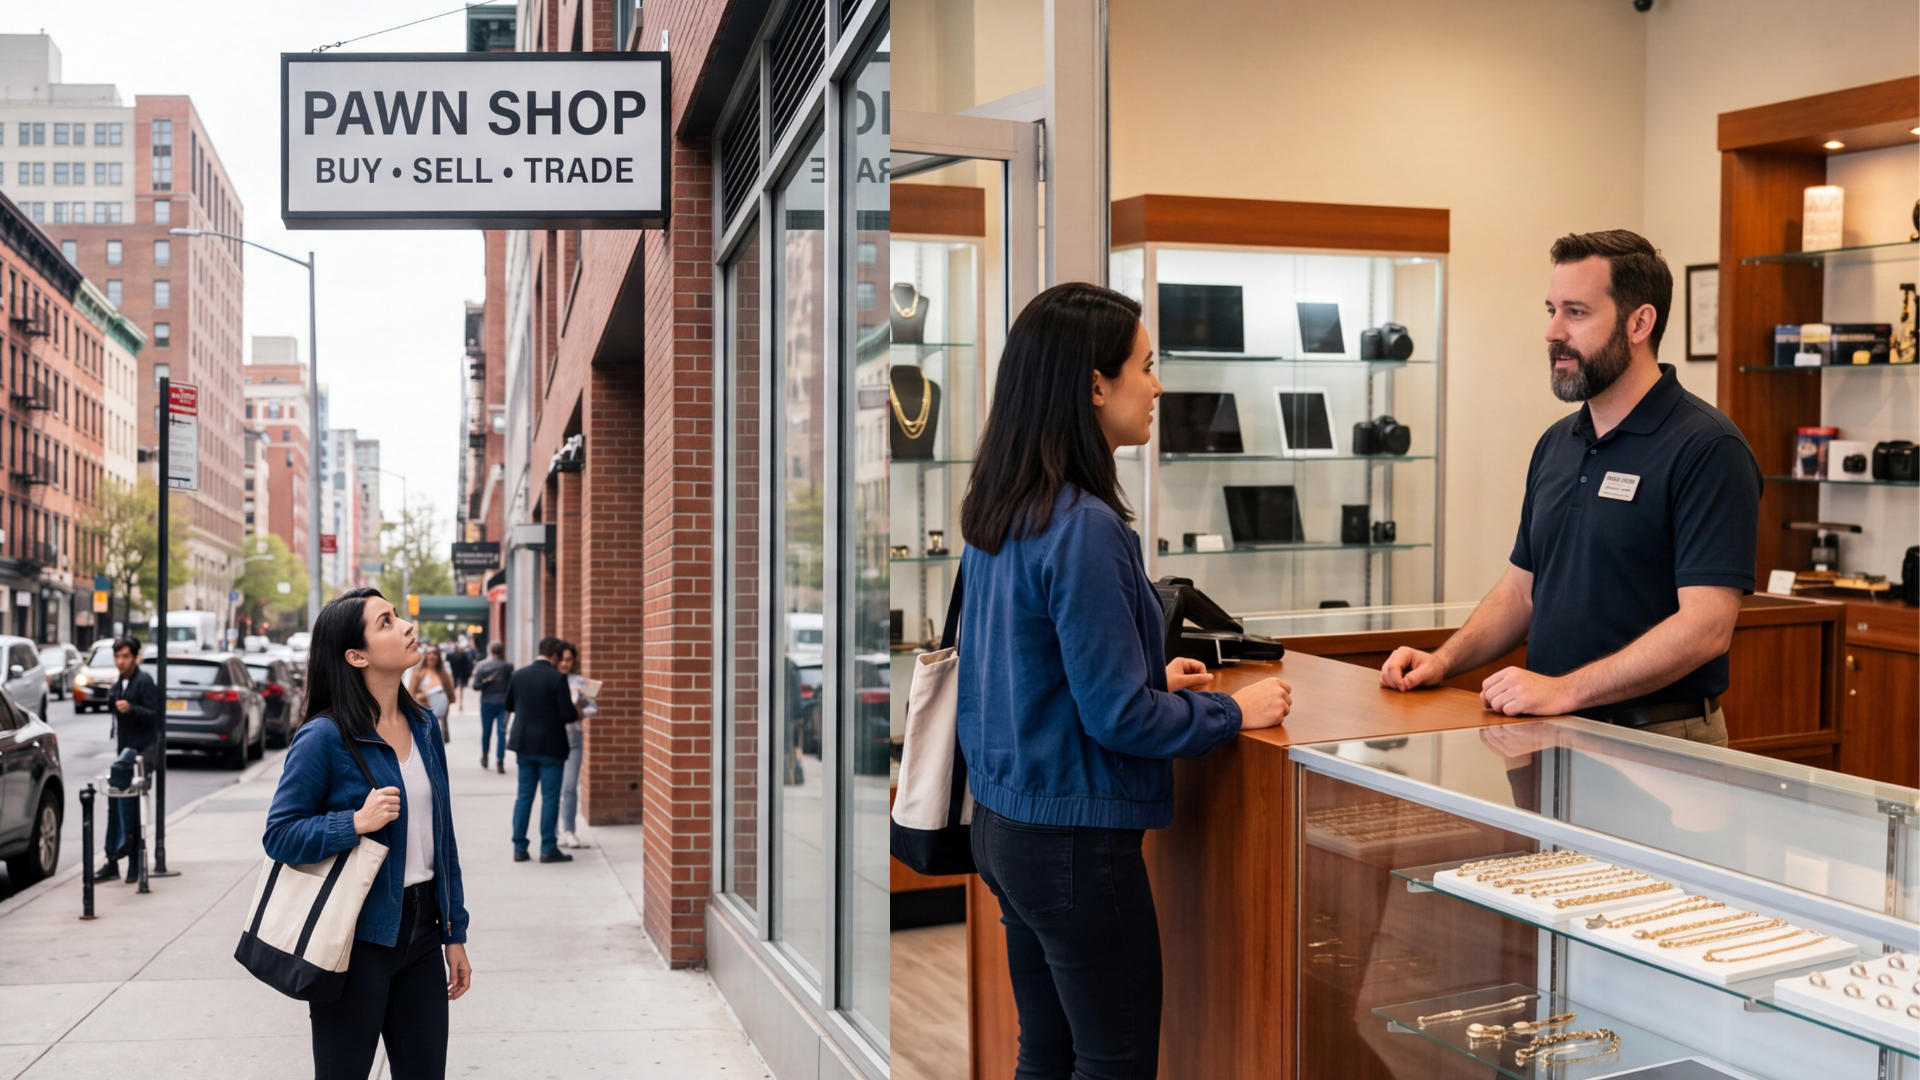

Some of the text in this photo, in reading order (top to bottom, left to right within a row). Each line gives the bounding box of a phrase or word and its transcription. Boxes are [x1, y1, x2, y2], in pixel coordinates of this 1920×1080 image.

[304, 89, 647, 136] PAWN SHOP
[316, 157, 634, 184] BUY SELL TRADE
